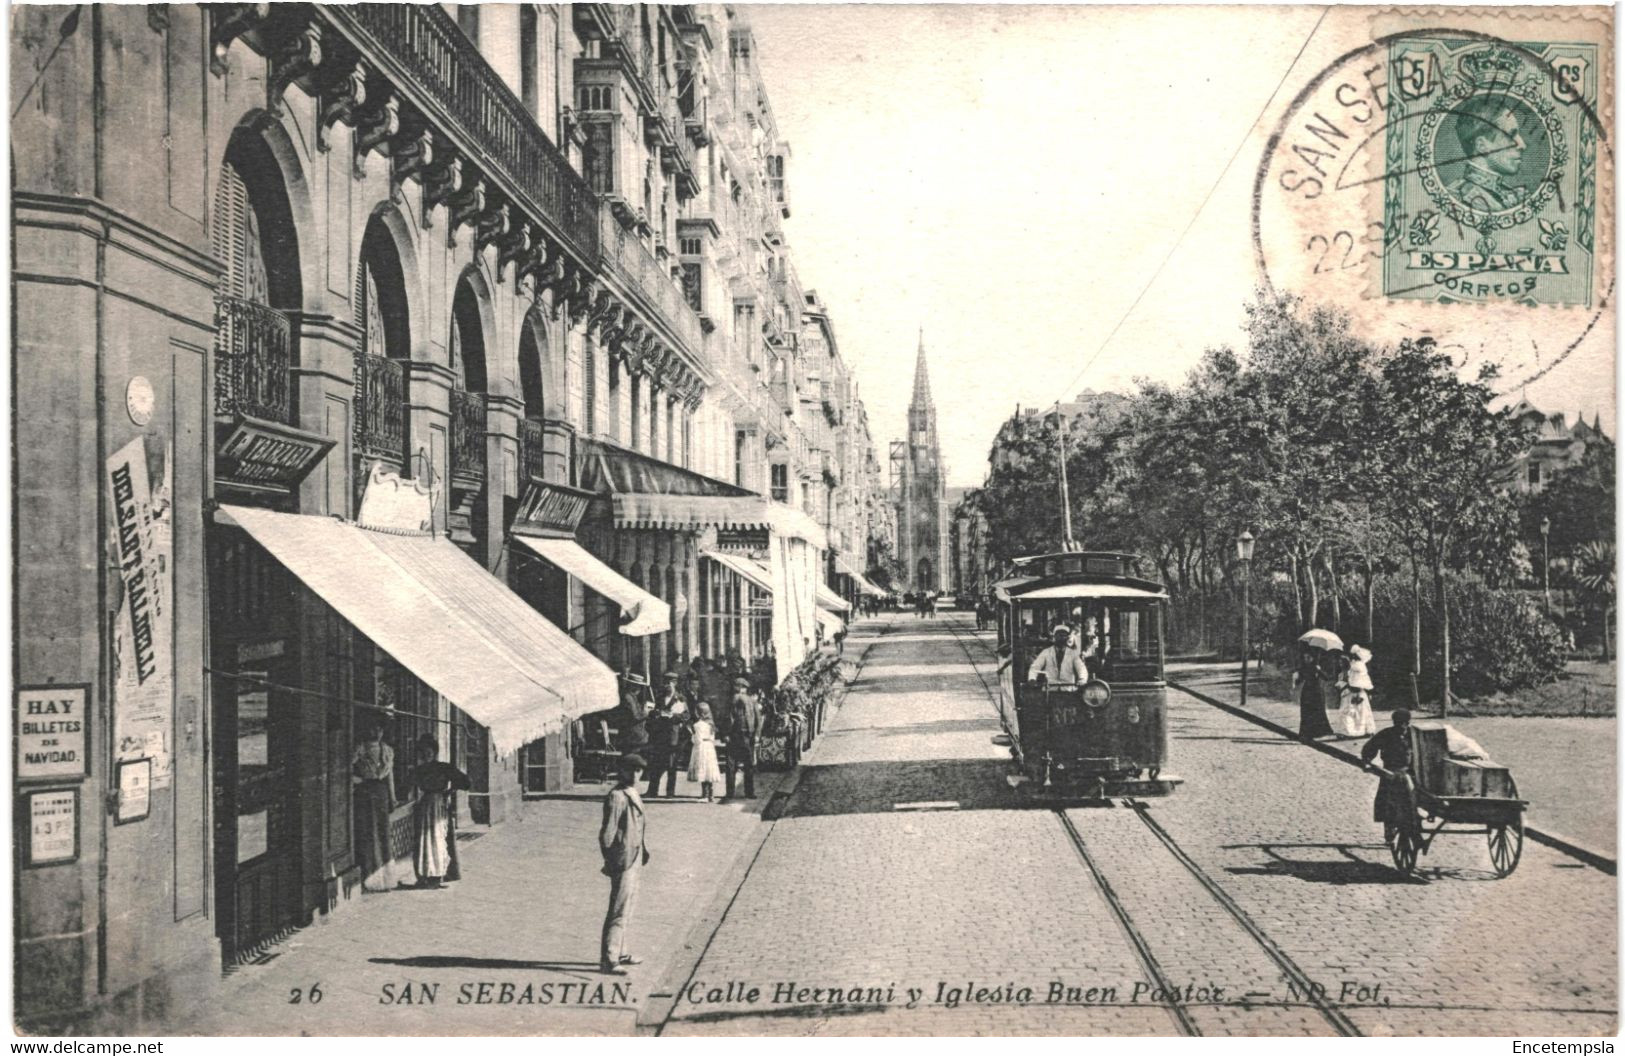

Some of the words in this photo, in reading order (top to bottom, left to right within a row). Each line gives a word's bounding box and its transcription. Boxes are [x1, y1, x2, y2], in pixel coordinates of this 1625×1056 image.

[1411, 60, 1425, 91] 5
[1280, 112, 1350, 199] SAN
[1307, 231, 1355, 275] 22
[1406, 248, 1569, 274] ESPAÑA
[1433, 272, 1538, 298] CORREOS
[27, 700, 75, 715] HAY
[22, 720, 81, 736] BILLETES
[41, 738, 60, 747] DE
